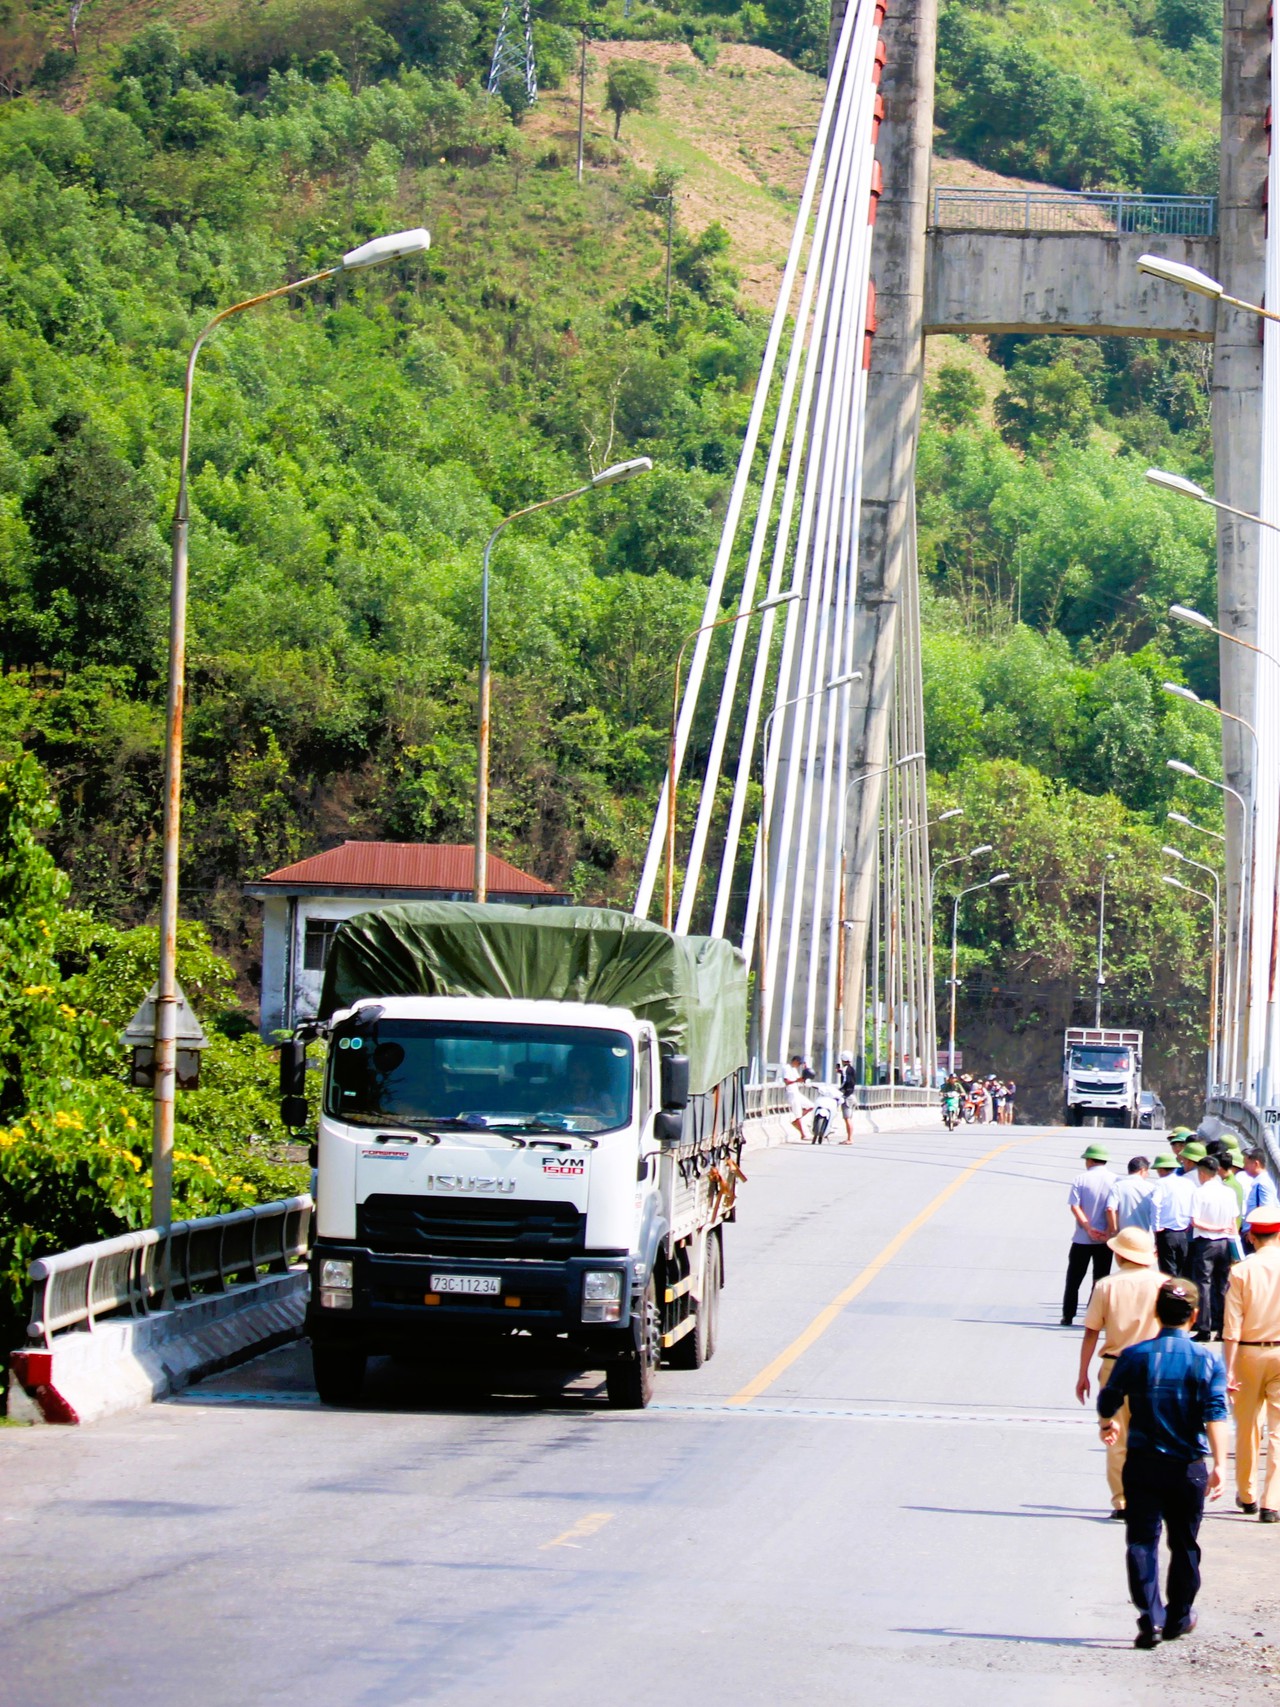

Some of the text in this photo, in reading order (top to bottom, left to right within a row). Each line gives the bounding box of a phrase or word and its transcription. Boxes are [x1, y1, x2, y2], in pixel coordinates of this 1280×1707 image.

[542, 1157, 584, 1167] FVM
[542, 1166, 584, 1175] 1500
[427, 1173, 517, 1194] ISUZU
